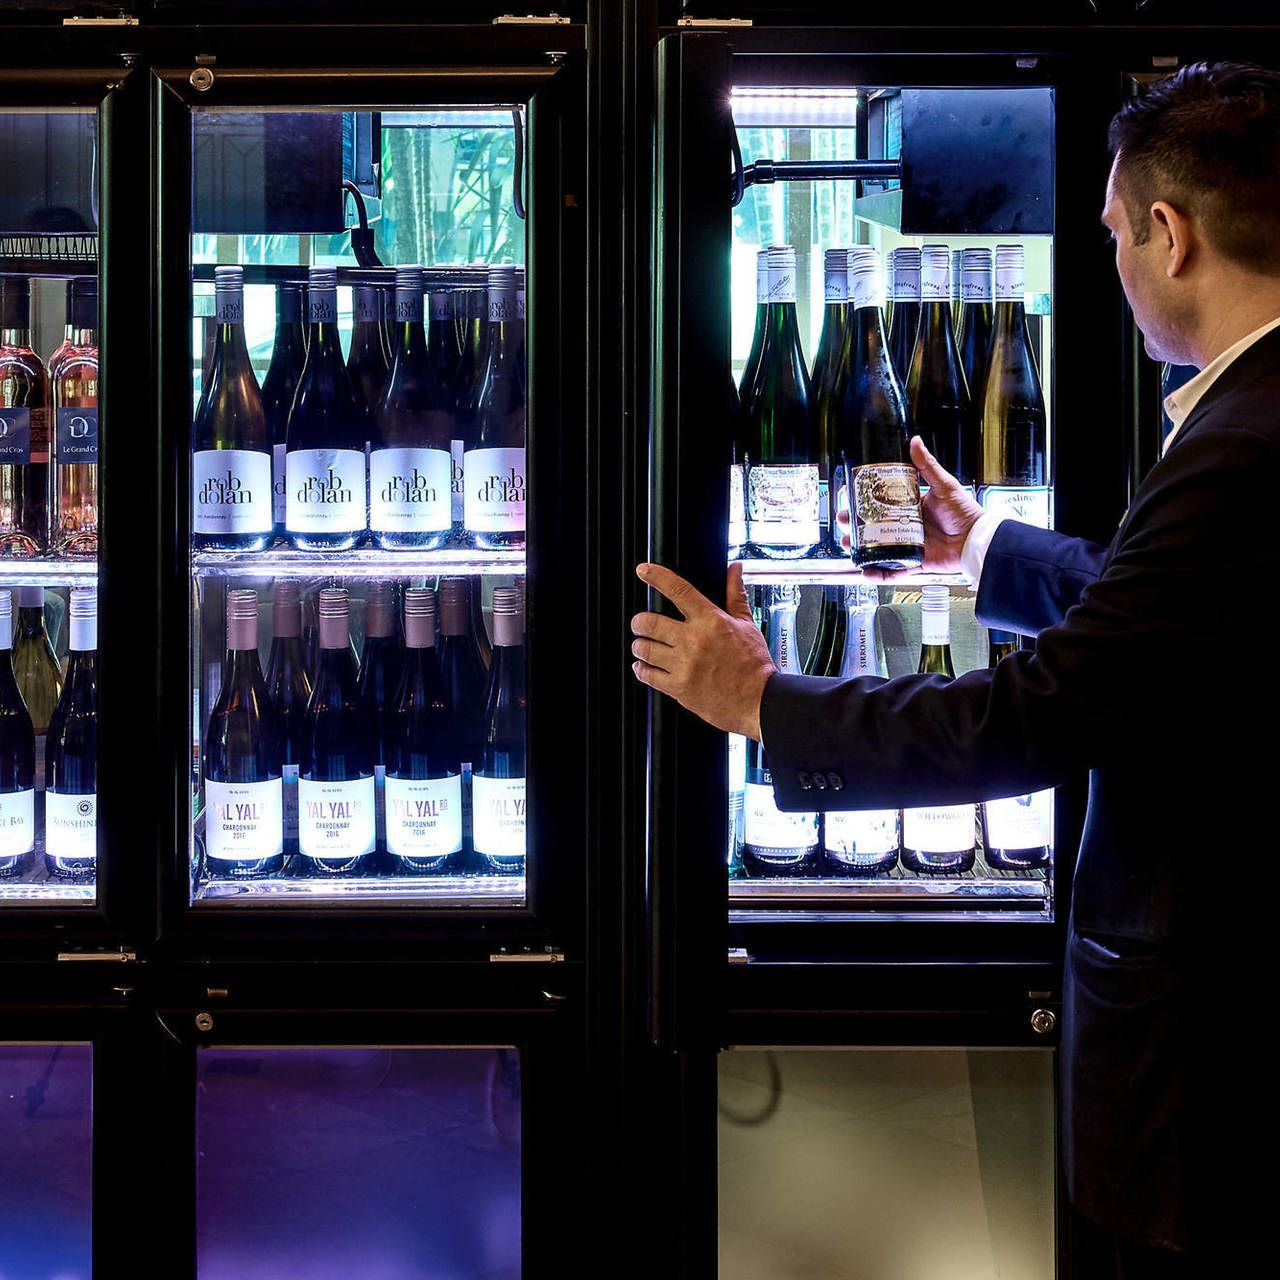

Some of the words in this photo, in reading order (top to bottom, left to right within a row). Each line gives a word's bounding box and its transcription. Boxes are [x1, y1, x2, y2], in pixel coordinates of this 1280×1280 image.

[70, 445, 89, 454] Grand
[207, 469, 242, 492] rob
[307, 468, 342, 491] rob
[391, 468, 427, 490] rob
[489, 467, 524, 489] rob
[198, 483, 252, 505] dolan
[297, 482, 352, 504] dolan
[381, 481, 436, 503] dolan
[859, 628, 867, 669] SIRROMET
[235, 802, 259, 821] YAL
[306, 800, 327, 819] YAL
[328, 801, 352, 819] YAL
[392, 799, 413, 817] YAL
[414, 799, 439, 818] YAL
[10, 816, 24, 826] BAY
[53, 816, 96, 828] SUNSHIN
[315, 822, 350, 830] CHARDONNAY
[402, 820, 436, 828] CHARDONNAY
